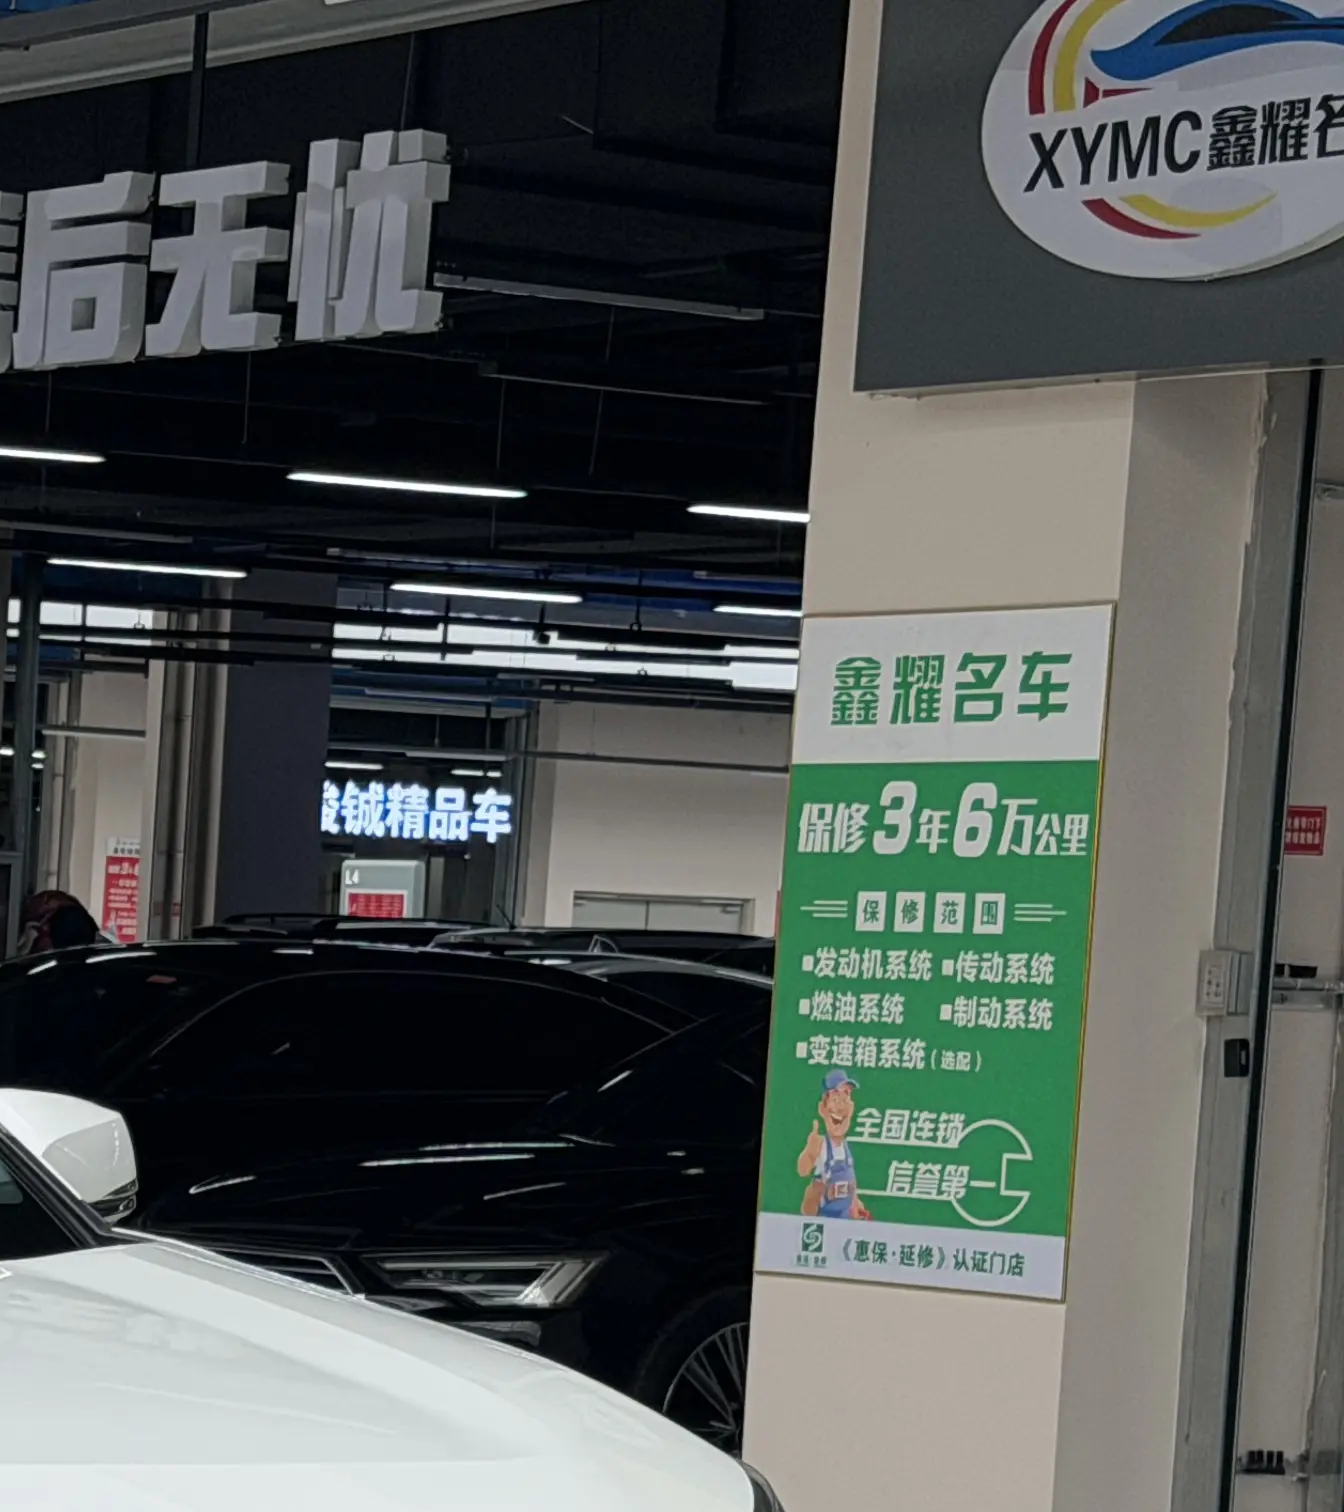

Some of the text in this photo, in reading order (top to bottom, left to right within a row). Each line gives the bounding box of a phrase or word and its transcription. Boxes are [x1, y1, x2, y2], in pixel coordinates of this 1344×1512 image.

[830, 651, 1073, 726] 鑫耀名车
[797, 780, 1089, 858] 保修3年6万公里
[345, 869, 359, 884] L4
[815, 947, 932, 981] 发动机系统
[956, 951, 1055, 985] 传动系统
[810, 990, 905, 1025] 燃油系统
[953, 996, 1053, 1031] 制动系统
[854, 1107, 966, 1145] 全国连锁
[886, 1160, 996, 1200] 信誉第一
